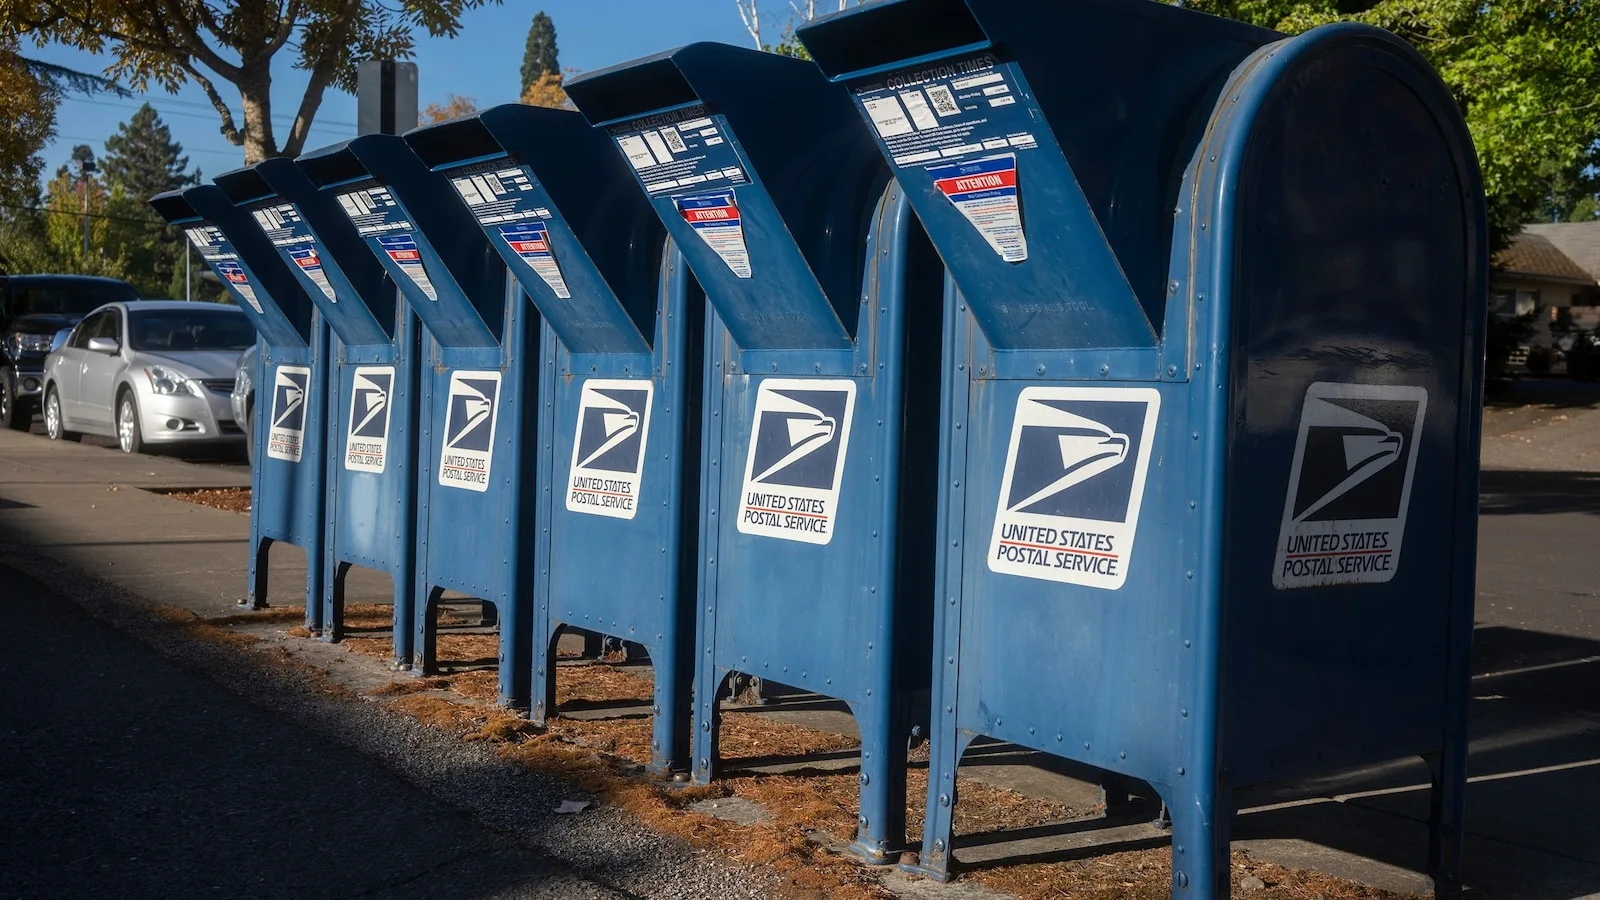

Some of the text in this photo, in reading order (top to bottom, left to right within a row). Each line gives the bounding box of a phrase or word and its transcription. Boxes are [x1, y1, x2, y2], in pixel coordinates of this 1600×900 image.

[886, 65, 957, 91] COLLECTION
[959, 56, 994, 75] TIMES
[632, 110, 681, 131] COLLECTION
[681, 105, 705, 119] TIMES
[955, 174, 1003, 191] ATTENTION
[694, 209, 729, 220] ATTENTION
[349, 442, 382, 454] UNITED STATES
[348, 454, 383, 467] POSTAL SERVICE
[444, 455, 485, 470] UNITED STATES
[442, 468, 486, 484] POSTAL SERVICE
[573, 476, 632, 494] UNITED STATES
[571, 491, 633, 510] POSTAL SERVICE
[747, 492, 825, 514] UNITED STATES
[744, 510, 827, 534] POSTAL SERVICE
[1001, 523, 1115, 552] UNITED STATES
[1287, 531, 1389, 554] UNITED STATES
[996, 544, 1118, 577] POSTAL SERVICE
[1282, 554, 1392, 578] POSTAL SERVICE
